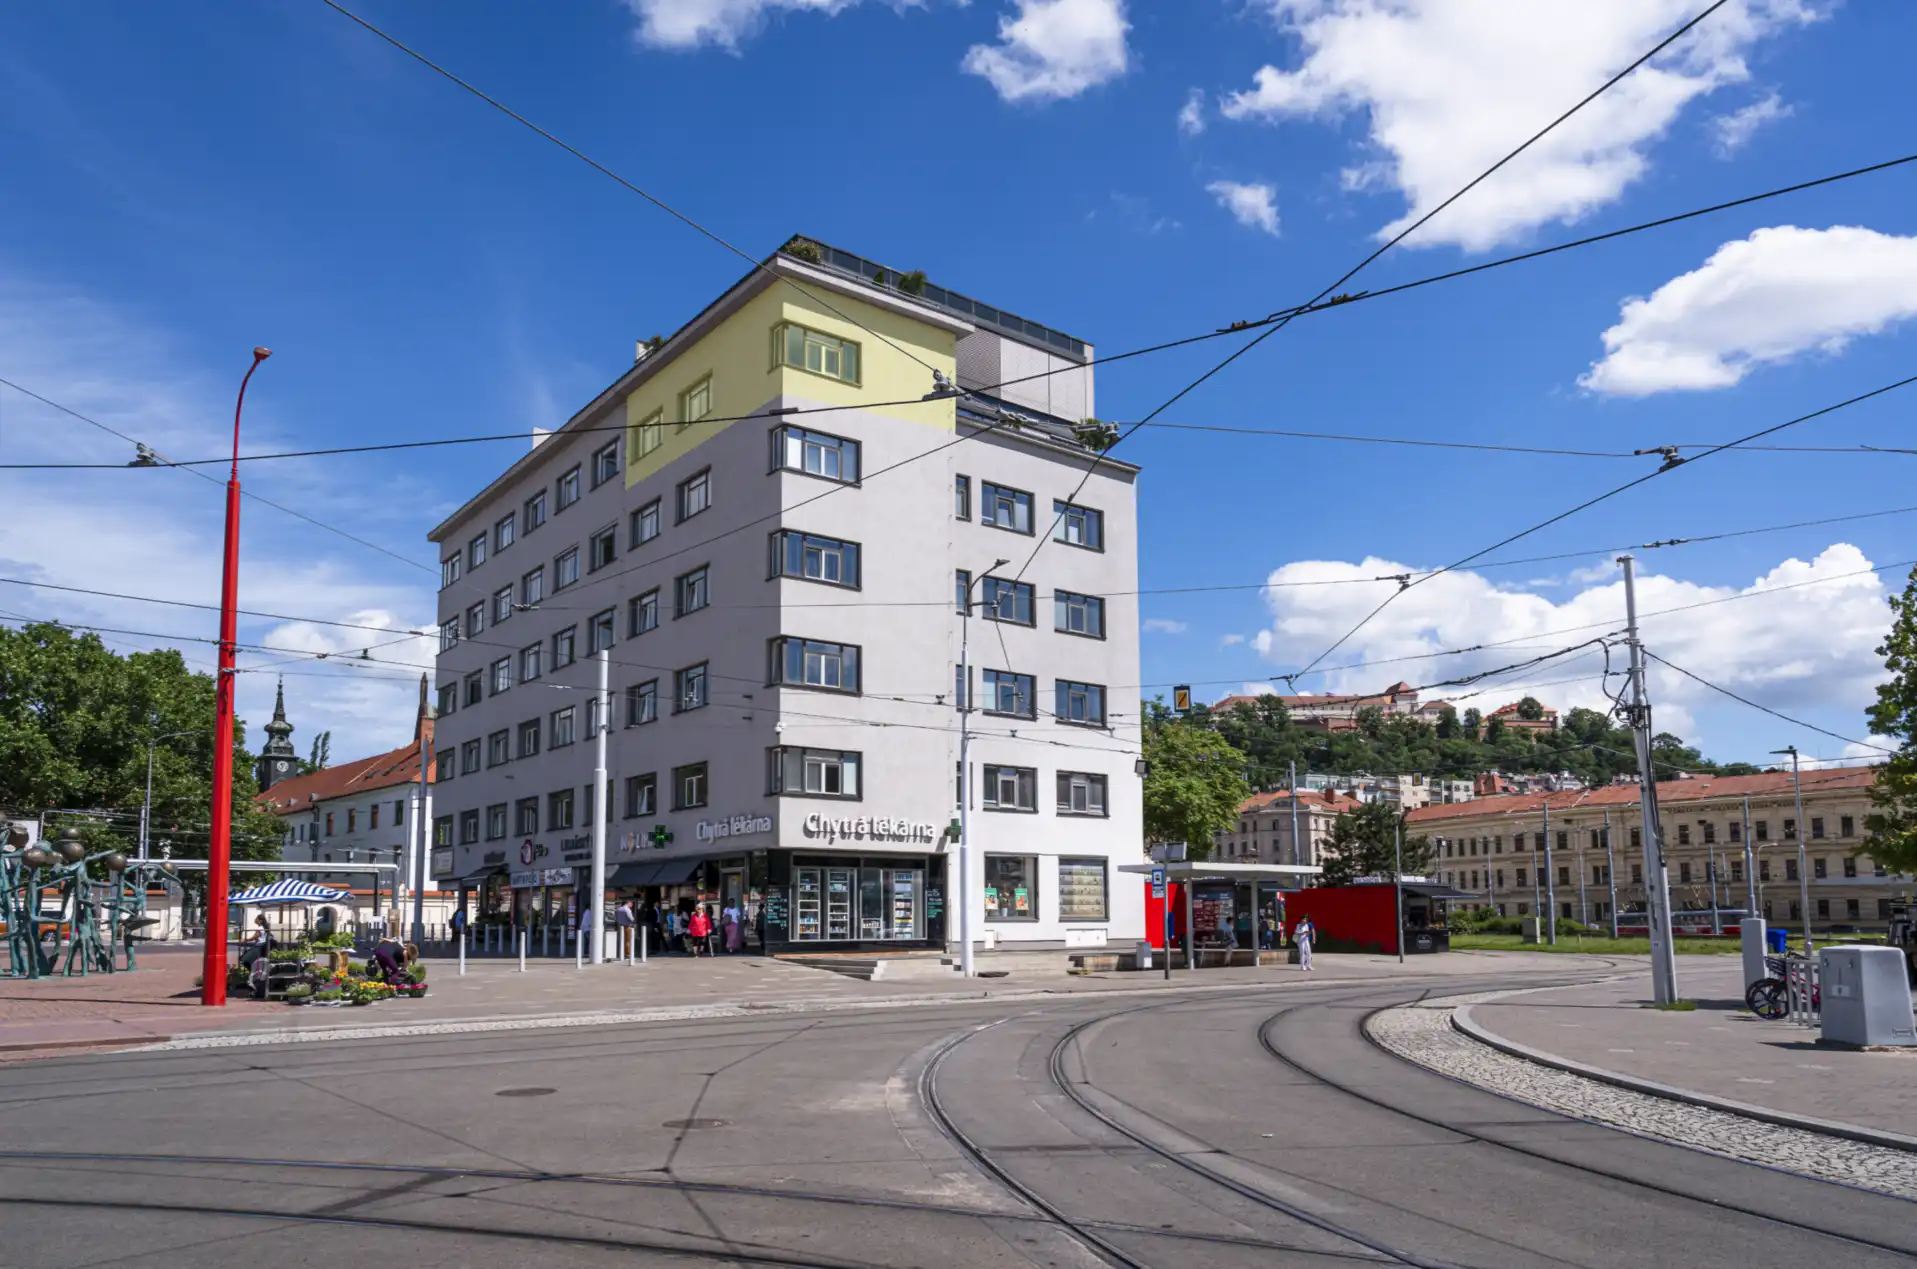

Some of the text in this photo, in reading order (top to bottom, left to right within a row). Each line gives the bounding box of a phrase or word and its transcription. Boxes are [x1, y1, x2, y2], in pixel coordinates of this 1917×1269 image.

[696, 814, 772, 844] Chytrá lékárna
[806, 812, 937, 838] Chytrá lékárna
